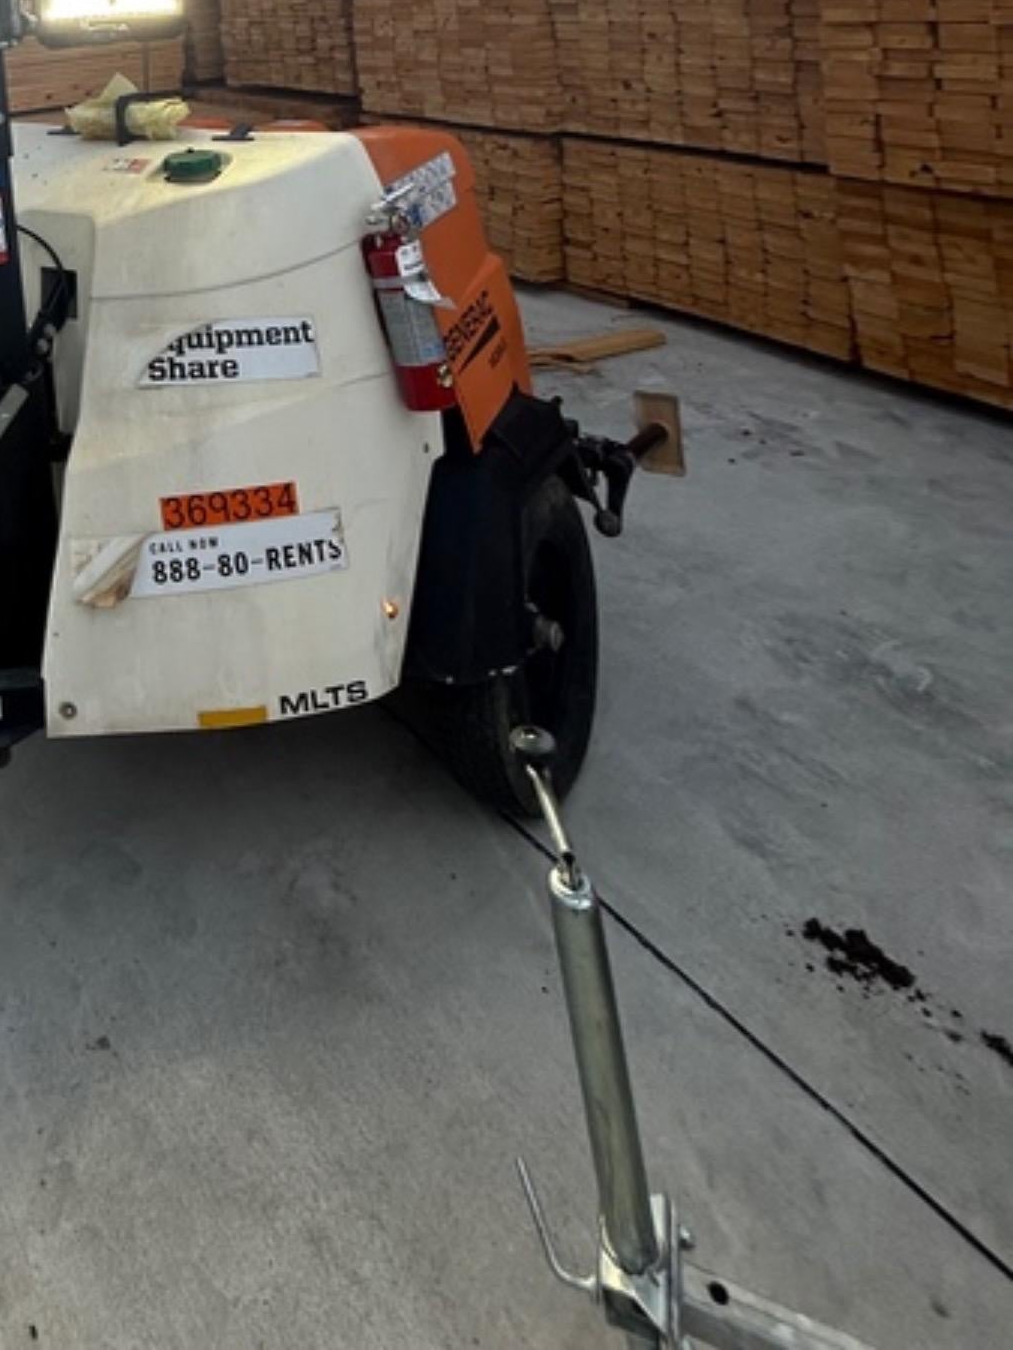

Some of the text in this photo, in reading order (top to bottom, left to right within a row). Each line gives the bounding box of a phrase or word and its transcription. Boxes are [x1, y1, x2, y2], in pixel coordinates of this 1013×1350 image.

[148, 356, 239, 381] Share
[162, 482, 295, 529] 369334
[149, 540, 183, 555] CALL
[152, 539, 342, 584] 888-80-RENTS
[280, 680, 368, 714] MLTS
